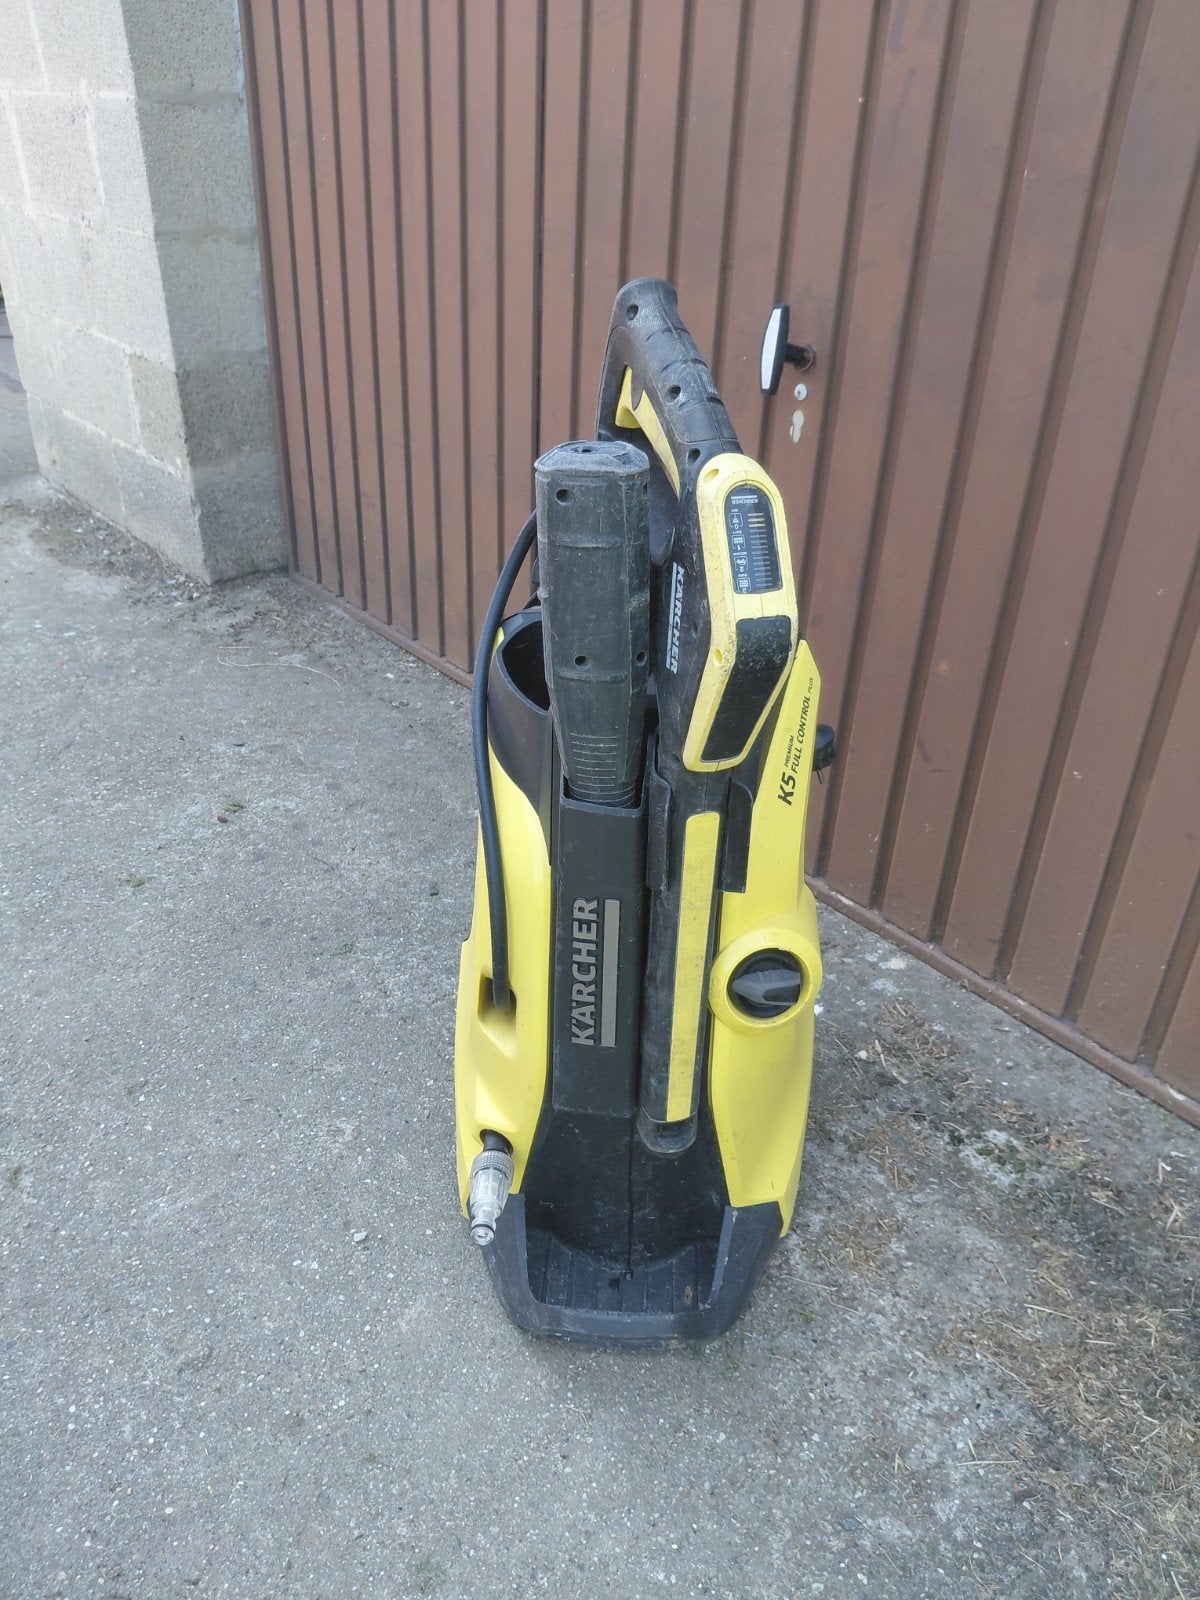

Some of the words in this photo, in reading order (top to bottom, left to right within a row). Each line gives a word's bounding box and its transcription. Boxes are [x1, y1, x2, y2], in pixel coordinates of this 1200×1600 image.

[796, 696, 811, 745] CONTROL
[784, 735, 795, 768] PREMIUM
[791, 746, 803, 774] FULL
[778, 772, 796, 806] K5
[570, 897, 598, 1046] KÄRCHER
